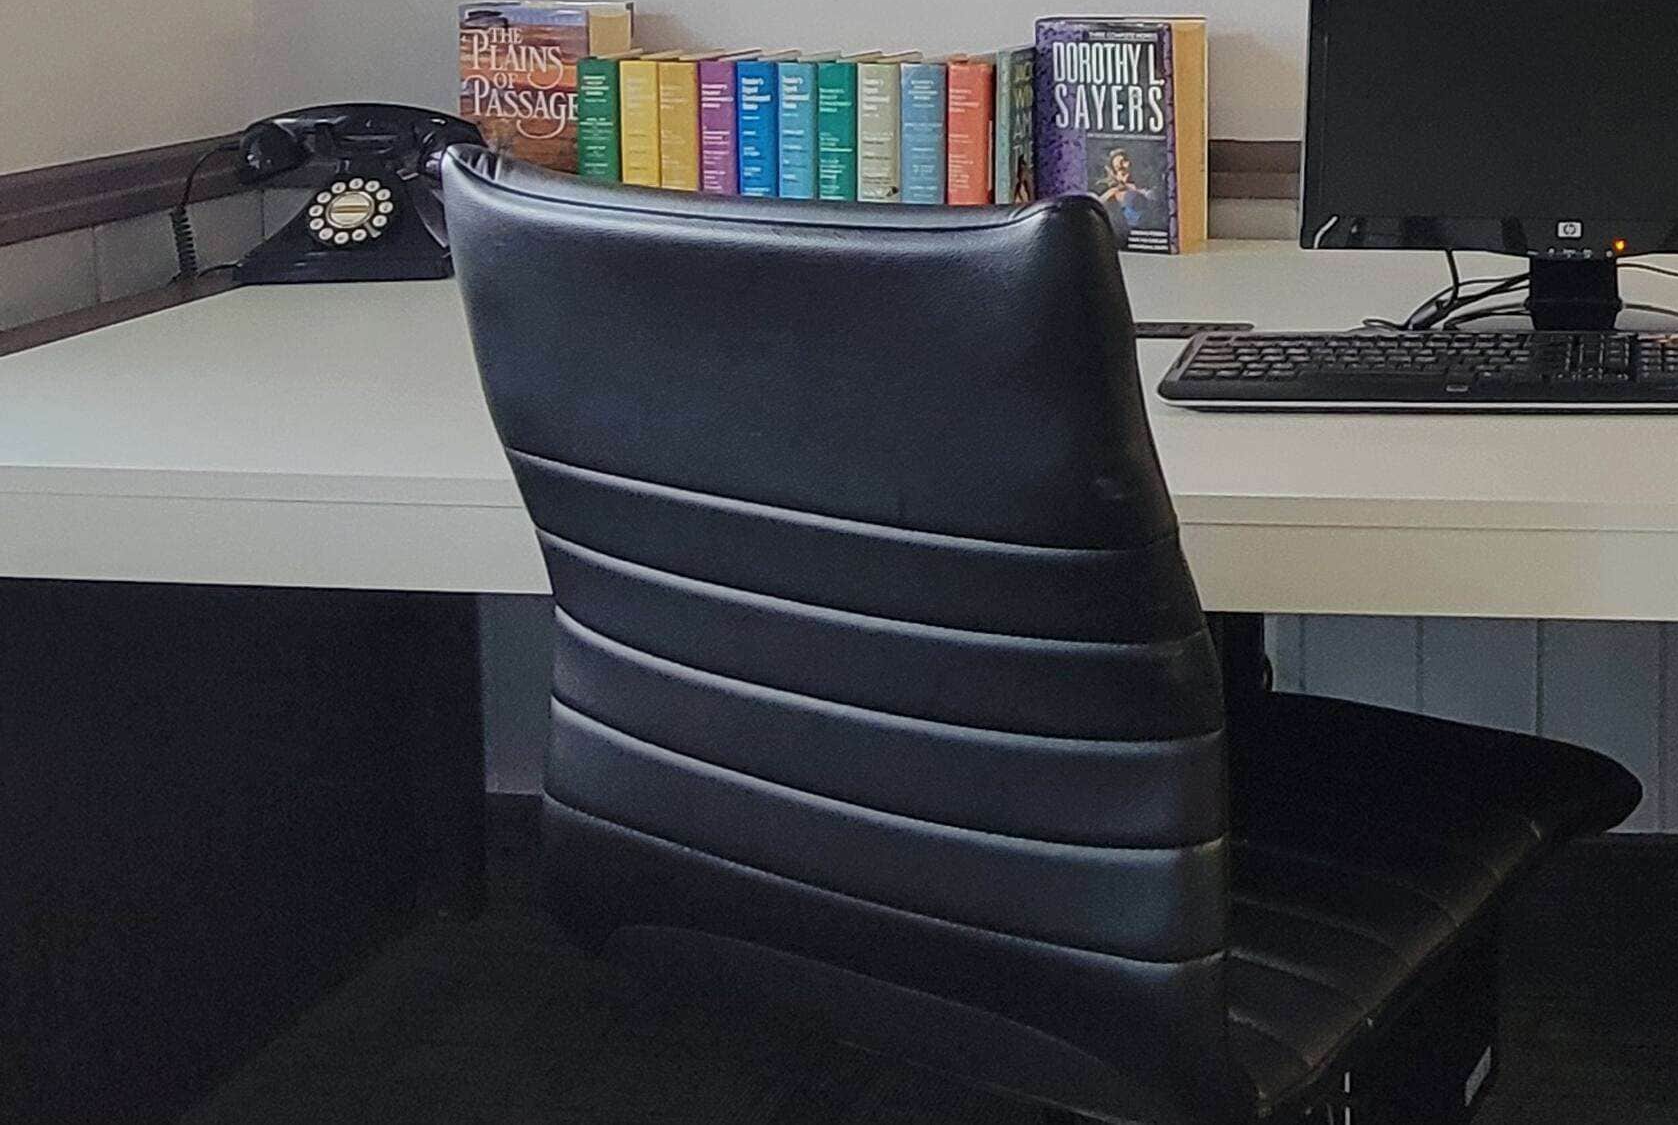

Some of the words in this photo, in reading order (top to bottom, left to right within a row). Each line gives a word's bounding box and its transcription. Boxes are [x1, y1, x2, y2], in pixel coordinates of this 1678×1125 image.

[489, 27, 523, 44] THE
[461, 29, 564, 90] PLAINS
[493, 72, 519, 89] OF
[1052, 41, 1142, 85] DOROTHY
[1148, 42, 1165, 86] L.
[463, 75, 579, 139] PASSAGE
[1054, 83, 1165, 133] SAYERS
